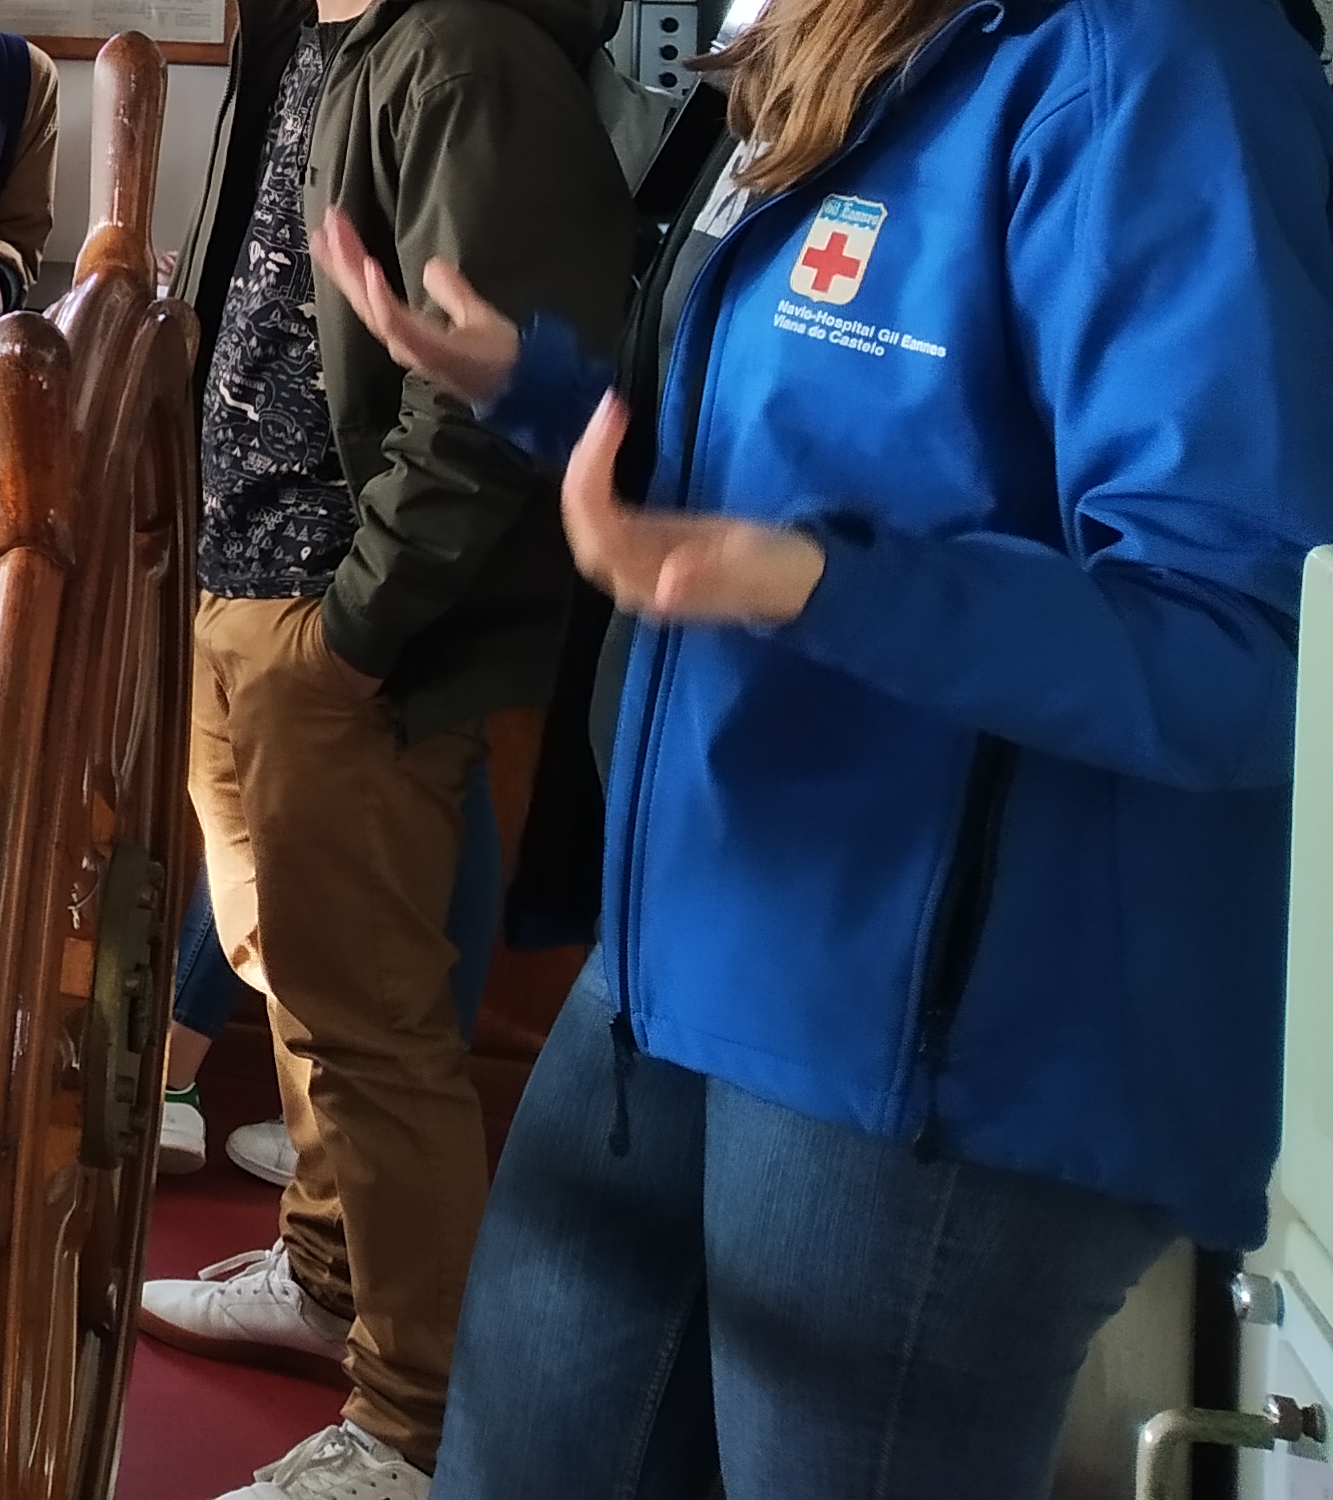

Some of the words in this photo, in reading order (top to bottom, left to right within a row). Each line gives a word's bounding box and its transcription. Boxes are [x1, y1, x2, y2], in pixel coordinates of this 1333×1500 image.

[773, 313, 807, 334] Viana
[808, 324, 827, 340] do
[828, 330, 885, 357] Castelo
[878, 328, 900, 346] Gil
